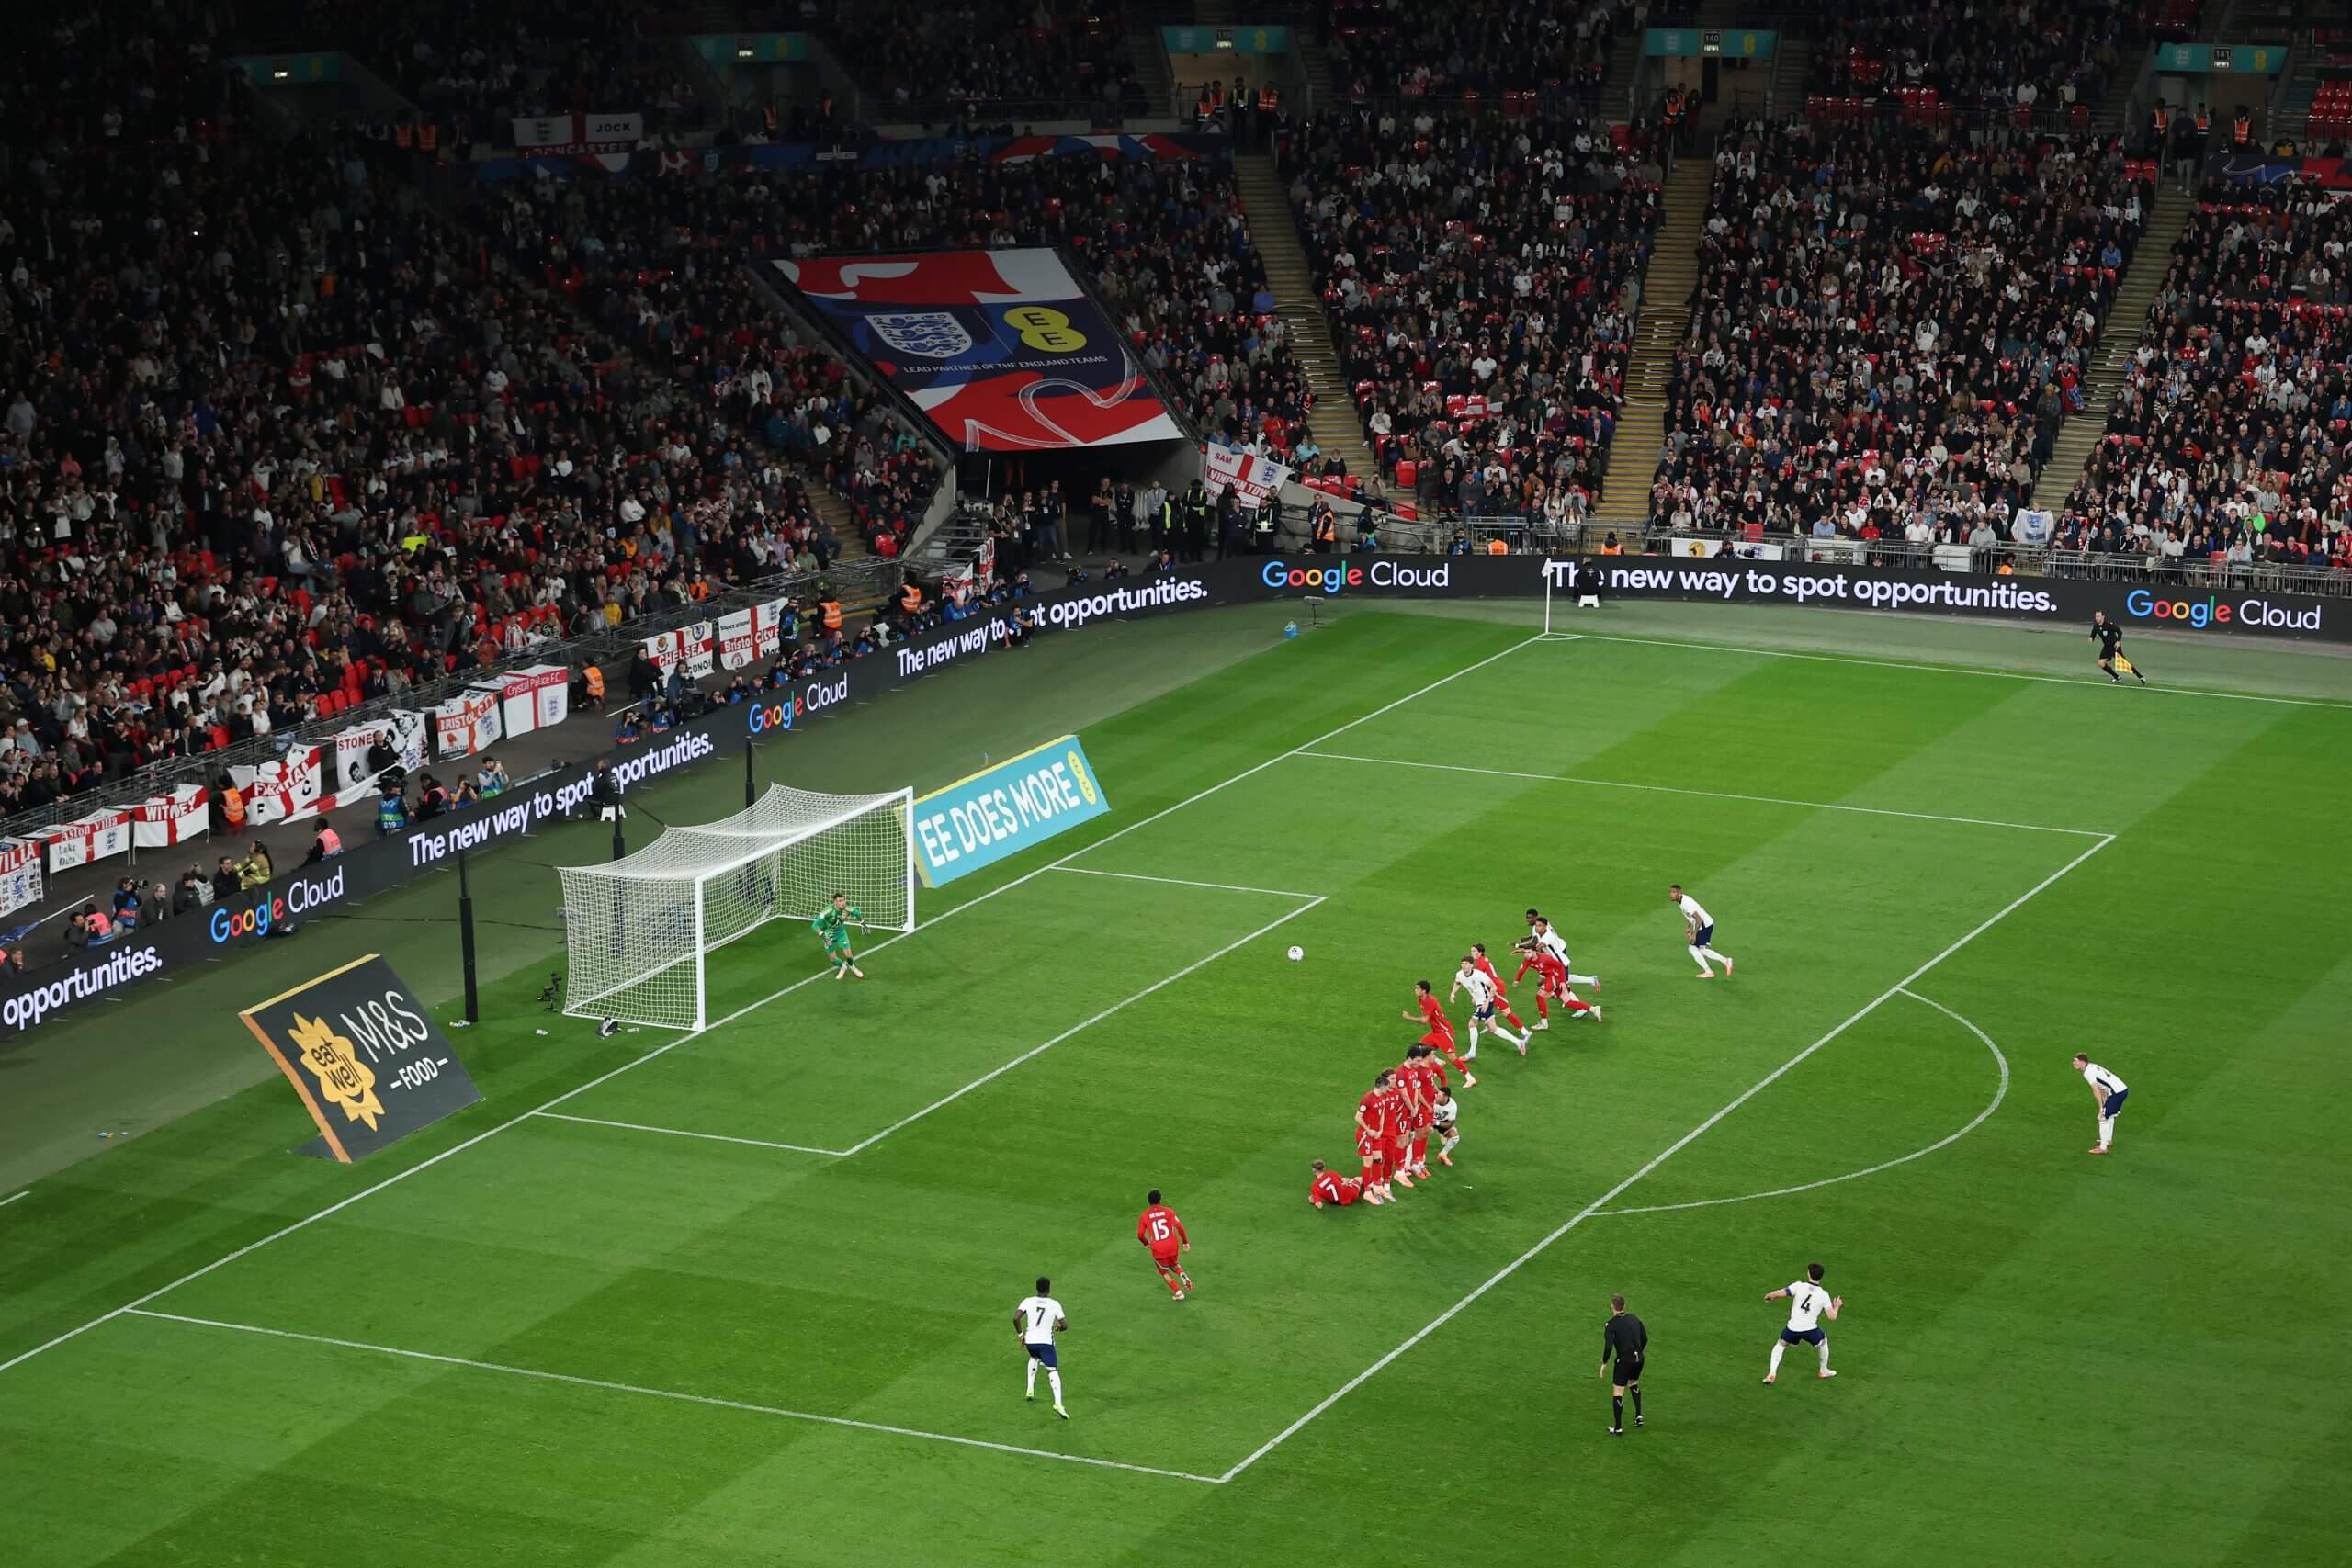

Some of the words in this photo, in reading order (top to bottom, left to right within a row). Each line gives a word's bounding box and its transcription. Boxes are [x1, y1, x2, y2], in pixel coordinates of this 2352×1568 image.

[596, 123, 631, 133] JOCK
[932, 364, 980, 373] PARTNER
[981, 362, 996, 370] OF
[1019, 357, 1069, 367] ENGLAND
[1069, 355, 1109, 365] TEAMS
[1214, 452, 1232, 464] SAM
[1262, 560, 1363, 593] Google
[1370, 561, 1449, 587] Cloud
[1611, 568, 1675, 590] new
[1679, 569, 1740, 599] way
[1746, 569, 1777, 595] to
[1782, 574, 1848, 603] spot
[1854, 581, 2058, 612] opportunities.
[2126, 589, 2233, 629] Google
[2239, 599, 2323, 630] Cloud
[724, 633, 752, 652] Bristol
[754, 627, 774, 644] City
[896, 648, 924, 677] The
[927, 637, 956, 660] new
[960, 626, 989, 654] way
[990, 617, 1006, 641] to
[1049, 576, 1208, 627] opportunities.
[658, 642, 706, 667] CHELSEA
[507, 681, 529, 696] Crystal
[749, 690, 804, 733] Google
[806, 671, 848, 711] Cloud
[145, 795, 197, 822] WITNEY
[408, 831, 447, 866] The
[448, 819, 490, 851] new
[492, 801, 532, 838] way
[532, 789, 553, 819] to
[554, 771, 594, 816] spot
[917, 813, 961, 868] EE
[949, 788, 1020, 854] DOES
[1007, 761, 1082, 829] MORE
[61, 825, 90, 842] Aston
[95, 816, 118, 831] Villa
[210, 889, 285, 943] Google
[288, 864, 344, 913] Cloud
[3, 945, 163, 1031] opportunities.
[340, 989, 429, 1063] M&S
[311, 1036, 341, 1067] eat
[324, 1053, 363, 1091] well
[1326, 1183, 1339, 1201] 7
[1152, 1218, 1170, 1241] 15
[1036, 1306, 1046, 1327] 7
[1800, 1293, 1812, 1314] 4
